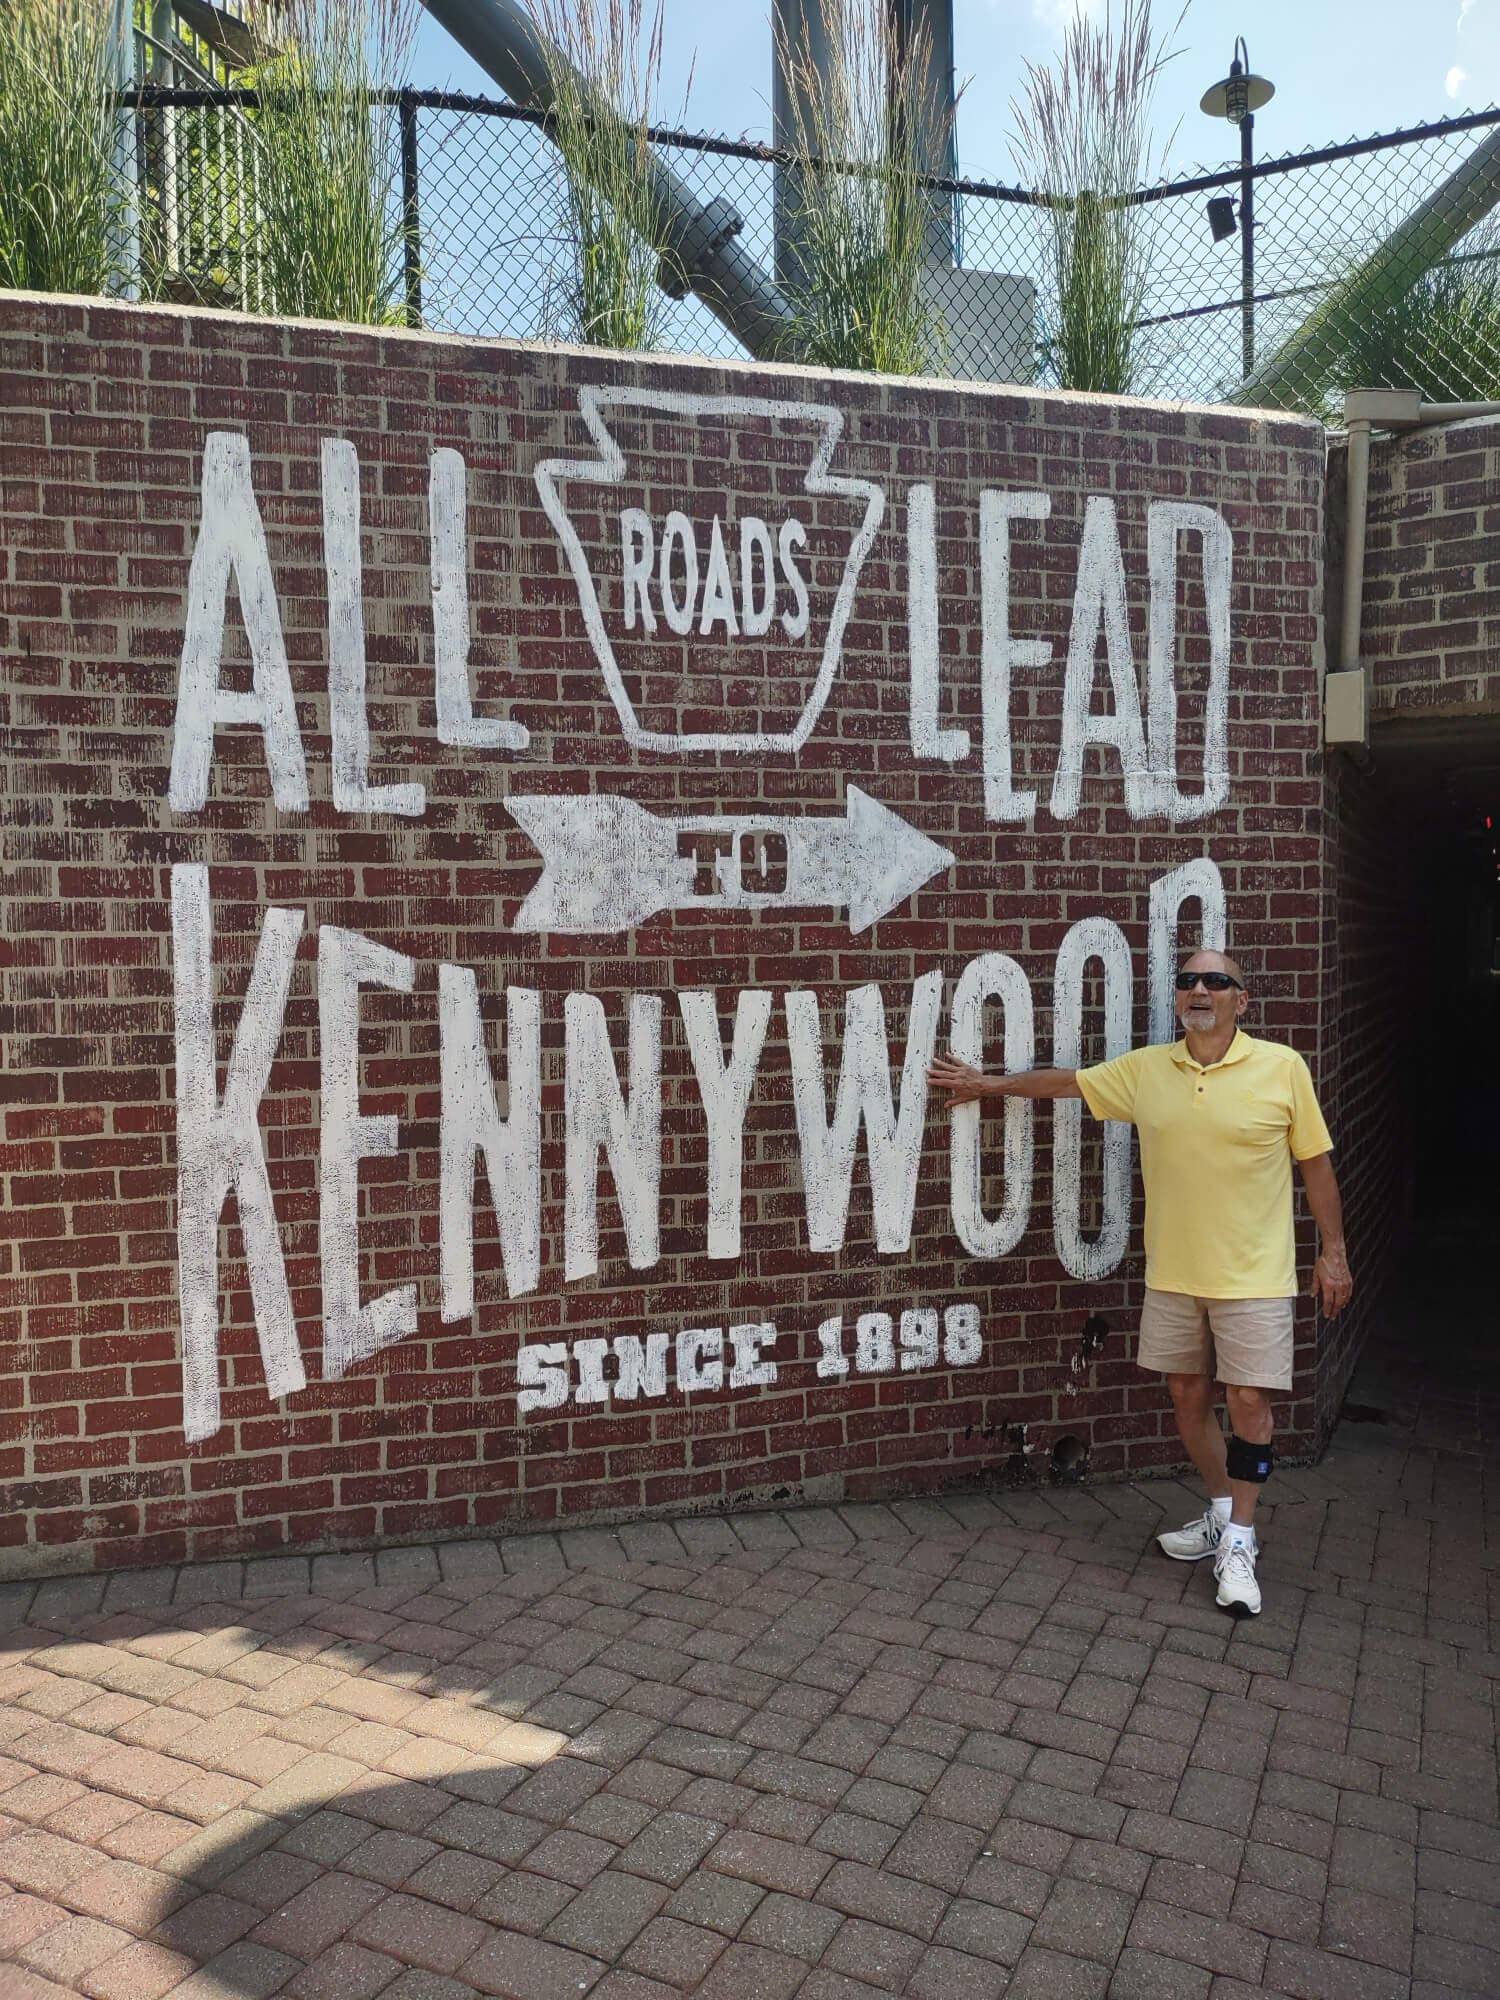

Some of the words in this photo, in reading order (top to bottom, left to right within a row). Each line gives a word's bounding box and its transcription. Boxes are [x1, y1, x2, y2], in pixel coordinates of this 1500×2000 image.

[168, 432, 532, 817] ALL
[620, 508, 810, 642] ROADS
[906, 483, 1234, 824] LEAD
[675, 829, 789, 897] TO
[516, 1322, 779, 1414] SINCE
[816, 1303, 984, 1379] 1898
